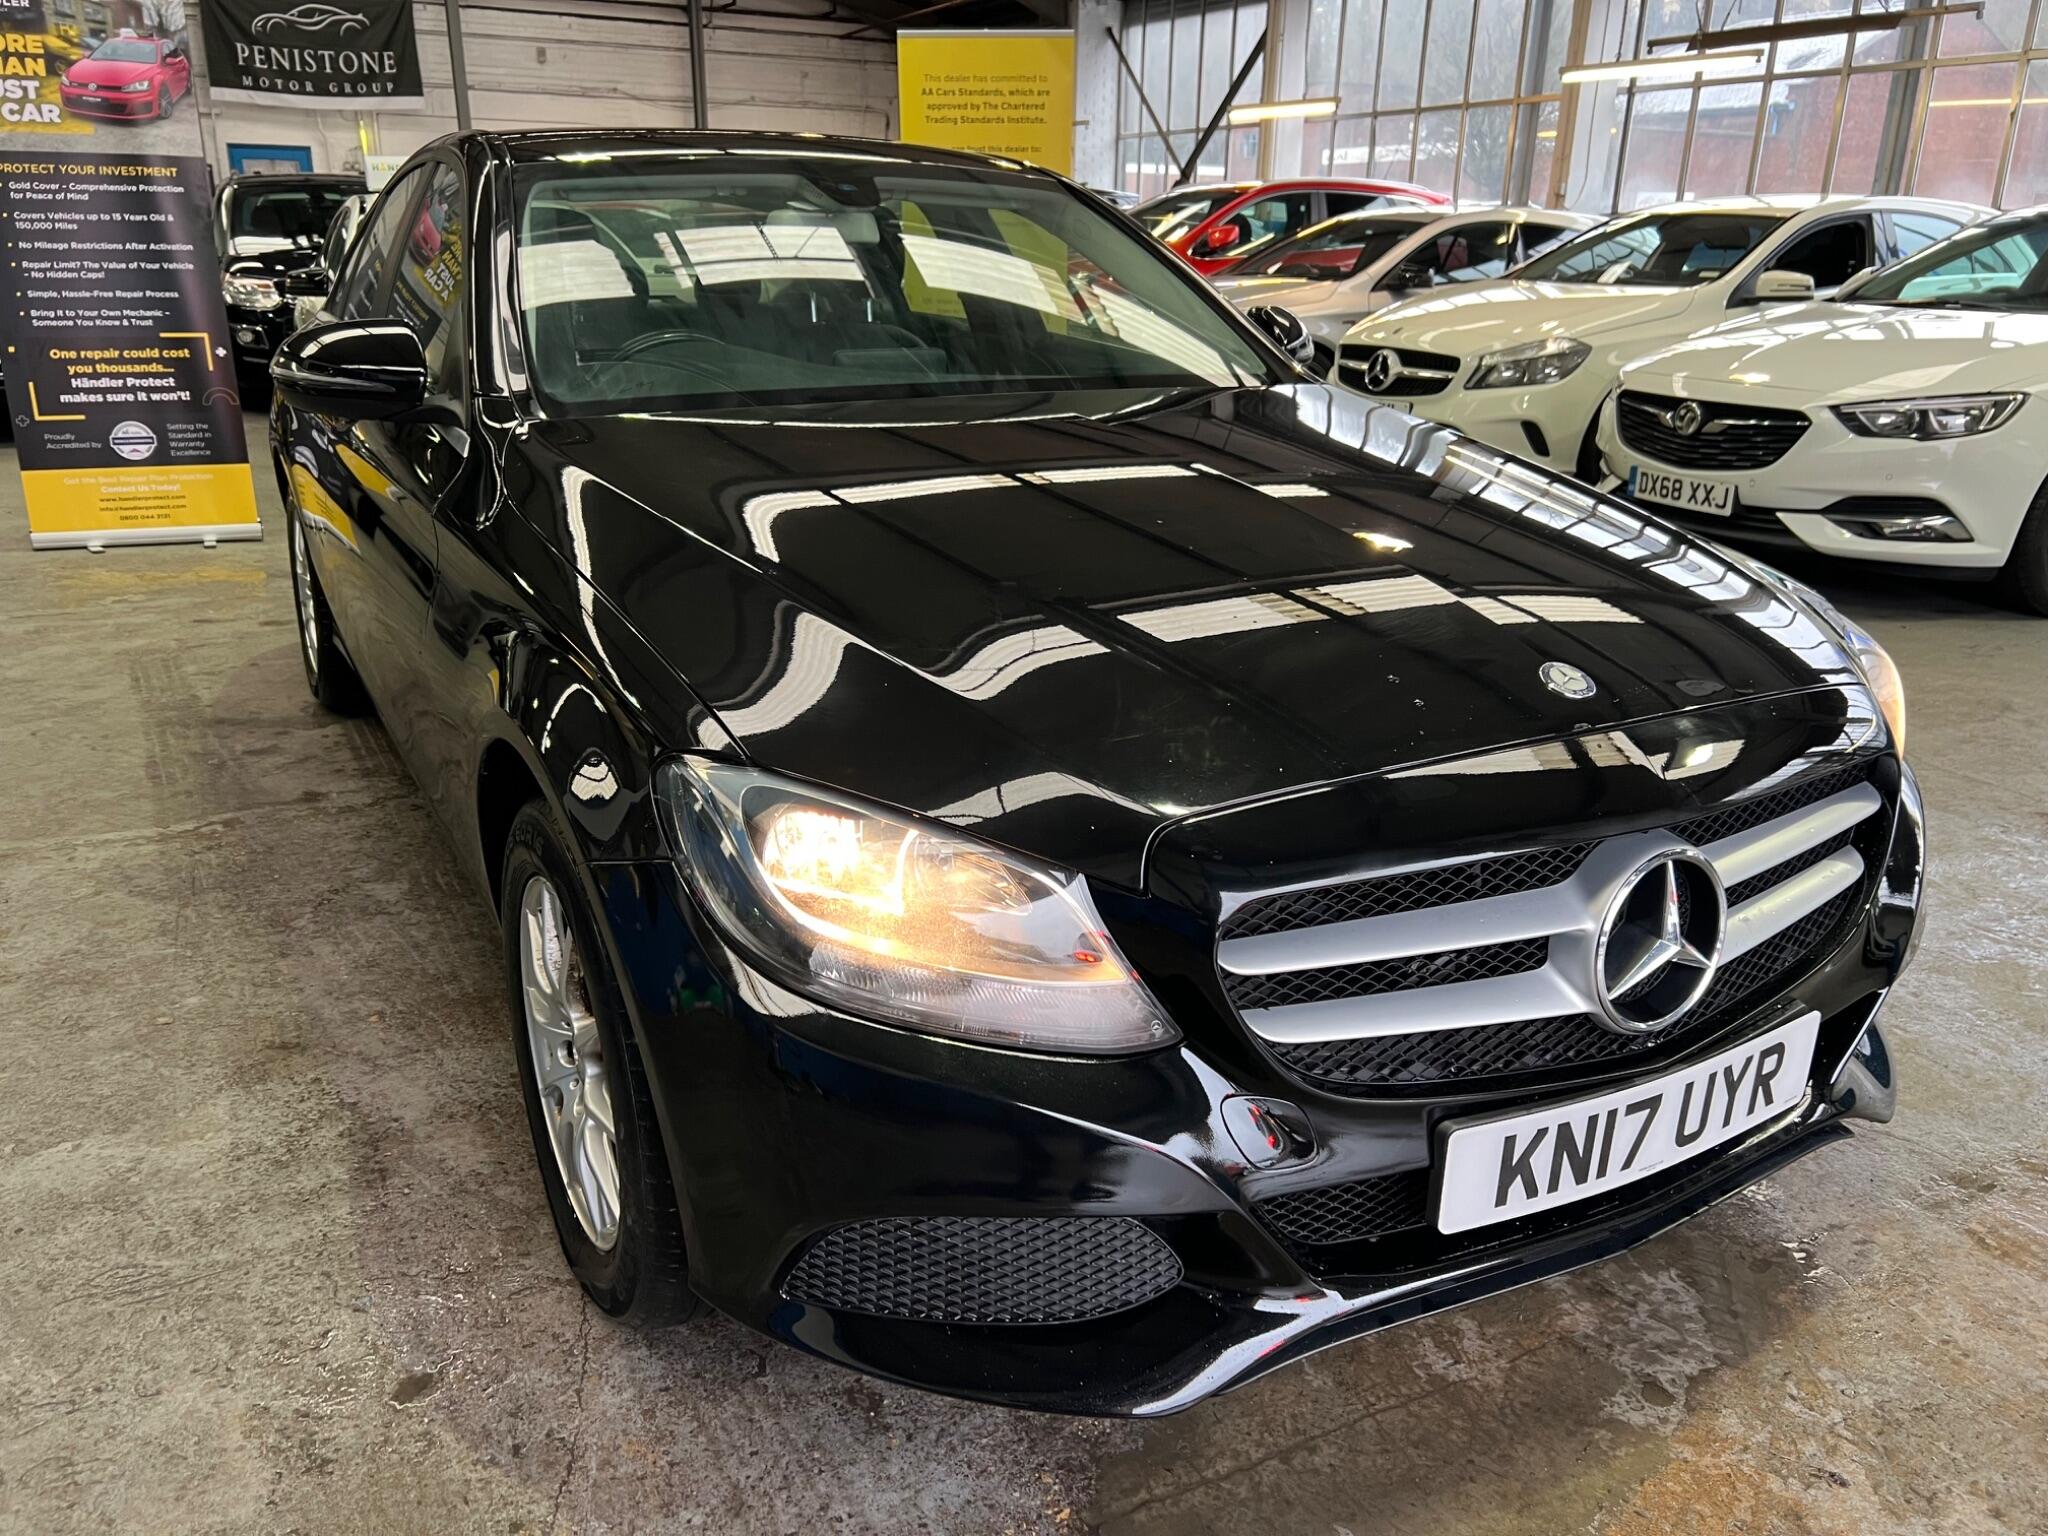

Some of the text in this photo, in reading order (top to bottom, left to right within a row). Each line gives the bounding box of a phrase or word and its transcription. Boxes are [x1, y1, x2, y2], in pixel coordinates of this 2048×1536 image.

[0, 0, 30, 8] LER
[235, 42, 397, 74] PENISTONE
[0, 56, 46, 77] AN
[924, 74, 1048, 83] This dealer has committed to
[242, 75, 394, 94] MOTOR GROUP
[921, 88, 1050, 98] AA Cars Standards, which are
[927, 102, 1045, 112] approved by The Chartered
[1, 103, 62, 123] CAR
[925, 115, 1047, 126] Trading Standards Institute.
[1004, 145, 1029, 153] dealer
[59, 164, 96, 176] YOUR
[99, 165, 178, 177] INVESTMENT
[9, 181, 30, 190] Gold
[33, 182, 59, 190] Cover
[69, 183, 137, 193] Comprehensive
[139, 184, 184, 193] Protection
[26, 192, 53, 200] Peace
[55, 192, 65, 200] of
[67, 192, 89, 200] Mind
[14, 211, 46, 220] Covers
[49, 212, 85, 221] Vehicles
[87, 214, 98, 222] up
[100, 213, 110, 221] to
[112, 213, 121, 221] 15
[123, 213, 147, 221] Years
[149, 214, 165, 222] Old
[15, 222, 78, 231] 150,000 Miles
[34, 242, 68, 251] Mileage
[71, 242, 123, 250] Restrictions
[125, 242, 147, 250] After
[149, 243, 193, 251] Activation
[22, 261, 194, 270] Repair Limit? The Value of Your Vehicle
[47, 270, 78, 278] Hidden
[80, 271, 105, 280] Caps!
[27, 290, 61, 299] Simple,
[62, 290, 114, 298] Hassle-Free
[116, 290, 143, 299] Repair
[30, 309, 55, 318] Bring
[77, 309, 98, 317] Your
[100, 309, 121, 317] Own
[123, 309, 163, 317] Mechanic
[33, 319, 73, 327] Someone
[95, 319, 120, 327] Know
[50, 348, 190, 361] One repair could cost
[67, 364, 93, 375] you
[71, 377, 175, 388] Händler Protect
[60, 392, 103, 403] makes
[106, 393, 135, 402] sure
[137, 391, 147, 401] it
[166, 423, 194, 431] Setting
[44, 433, 75, 441] Proudly
[168, 431, 205, 439] Standard
[46, 441, 102, 449] Accredited by
[169, 440, 205, 449] Warranty
[171, 449, 211, 457] Excellence
[102, 485, 135, 493] Contact
[151, 484, 180, 492] Today!
[1638, 472, 1729, 510] DX68 XXJ
[1494, 1041, 1786, 1209] KN17 UYR
